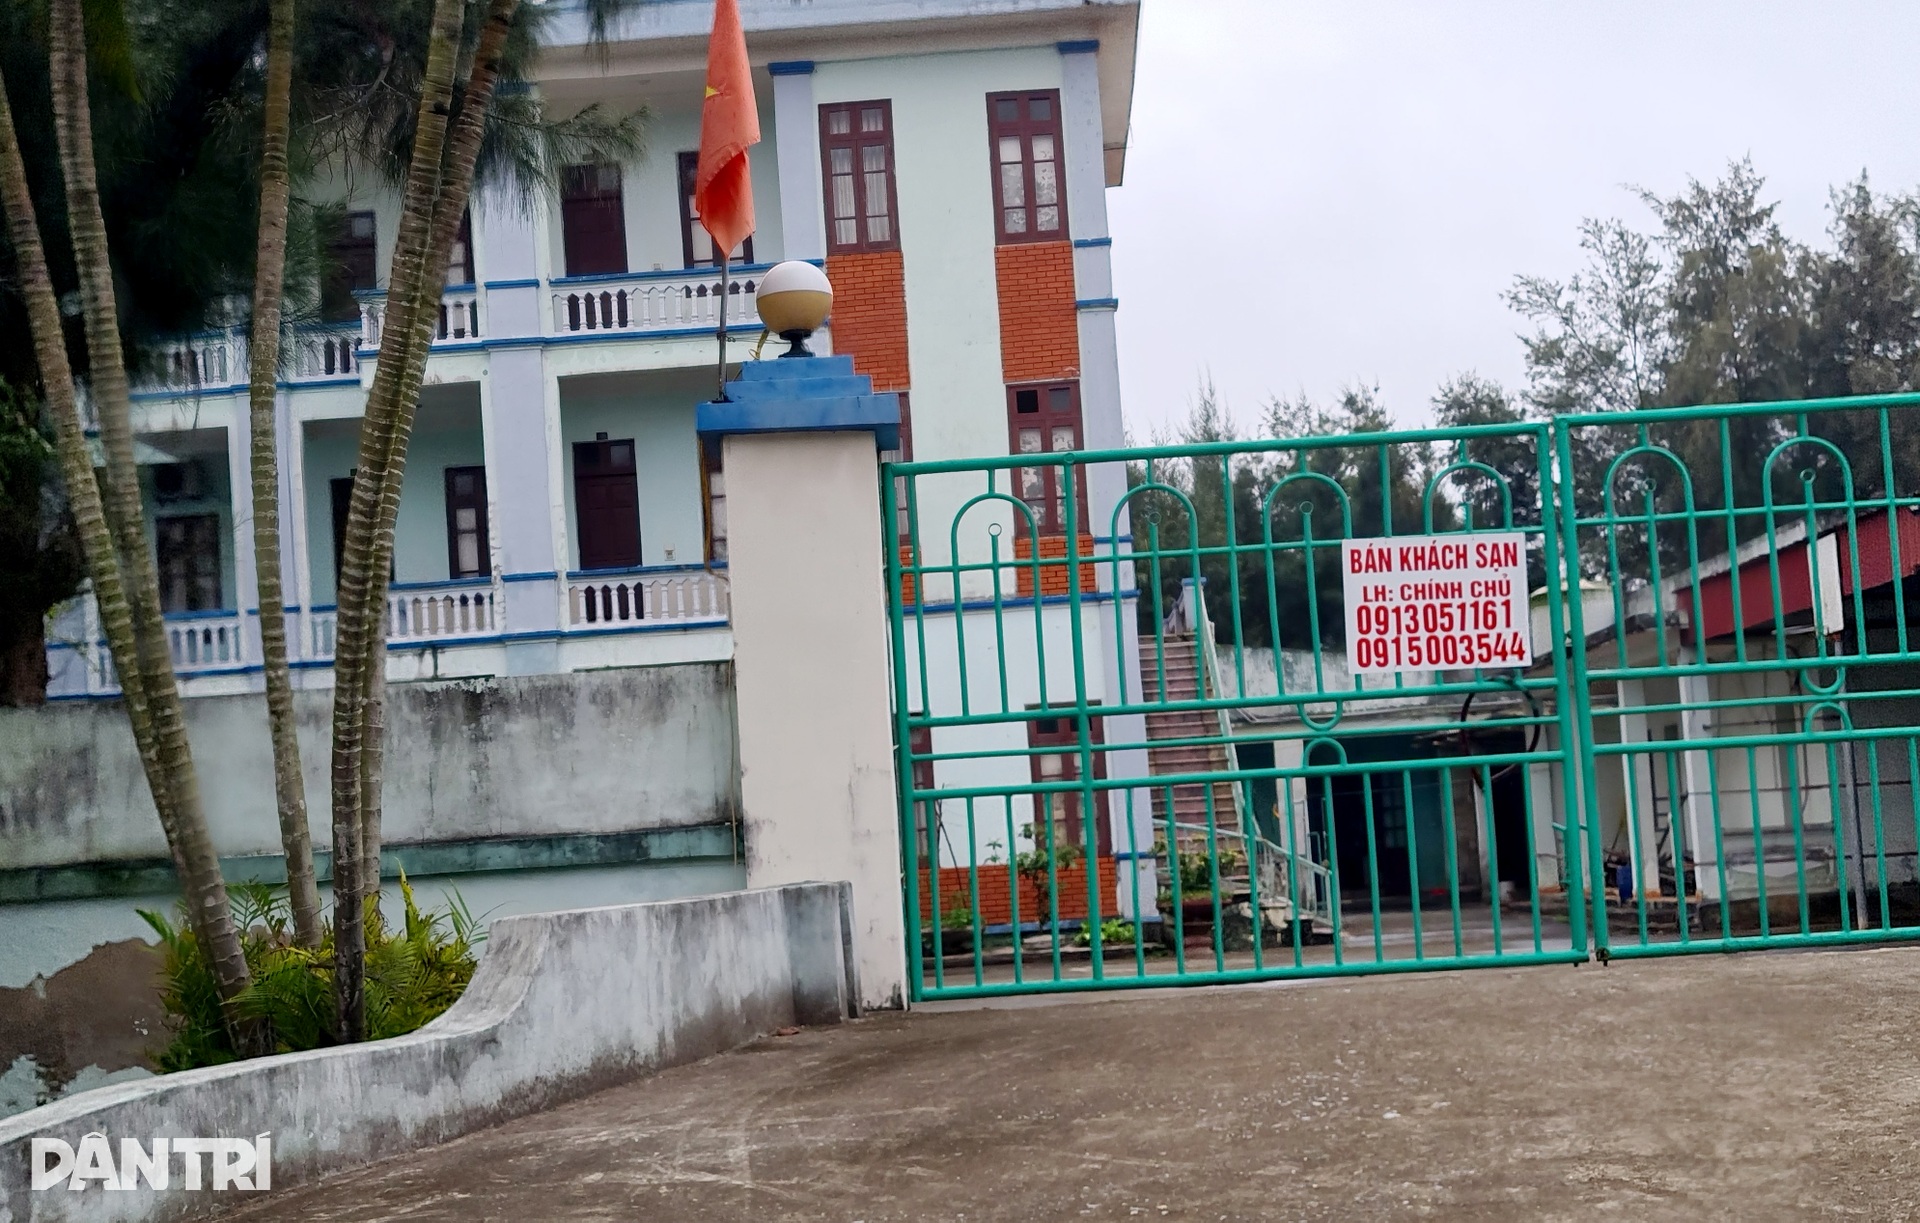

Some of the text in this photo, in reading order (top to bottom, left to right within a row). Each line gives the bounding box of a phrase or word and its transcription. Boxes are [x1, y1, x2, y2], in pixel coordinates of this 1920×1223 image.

[1350, 540, 1518, 574] BÁN KHÁCH SẠN
[1362, 573, 1511, 603] LH: CHÍNH CHỦ
[1356, 599, 1511, 636] 0913051161
[1356, 631, 1526, 668] 0915003544
